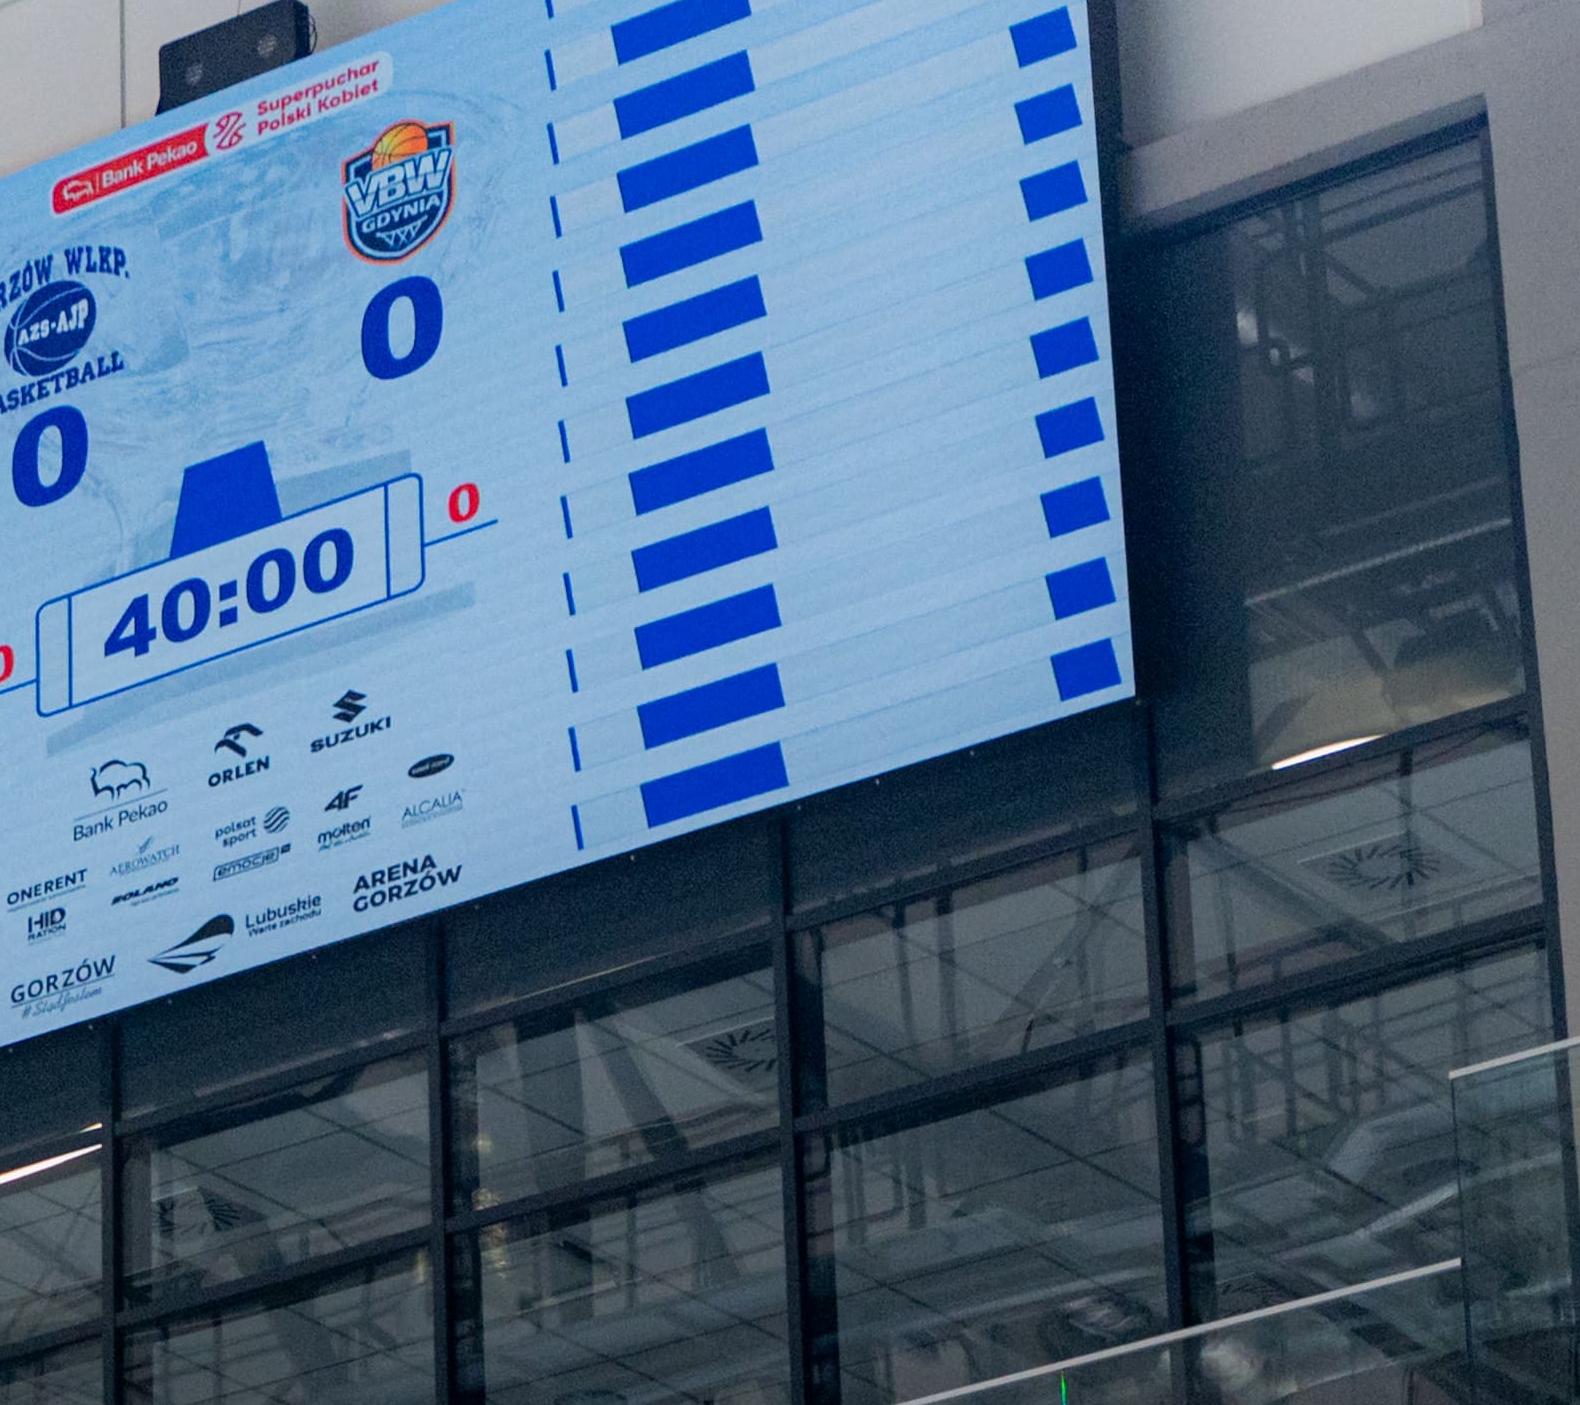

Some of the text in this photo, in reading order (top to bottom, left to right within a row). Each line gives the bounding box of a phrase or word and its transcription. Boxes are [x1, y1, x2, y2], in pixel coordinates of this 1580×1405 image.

[257, 60, 379, 116] Superpuchar
[257, 79, 379, 135] Polski Kobiet
[101, 140, 198, 188] Bank Pekao
[345, 148, 452, 217] VBW
[361, 194, 441, 233] GDYNIA
[64, 245, 130, 279] WLKP.
[361, 276, 444, 380] 0
[11, 406, 89, 507] 0
[448, 482, 480, 522] 0
[103, 527, 354, 658] 40:00
[310, 715, 392, 753] SUZUKI
[208, 755, 270, 787] ORLEN
[73, 800, 168, 841] Bank Pekao
[214, 816, 257, 840] polsat
[222, 828, 257, 848] sport
[317, 817, 371, 844] molten
[7, 867, 88, 905] ONERENT
[353, 855, 437, 894] ARENA
[353, 865, 463, 912] GORZÓW
[245, 893, 321, 929] Lubuskie
[11, 954, 116, 1004] GORZÓW
